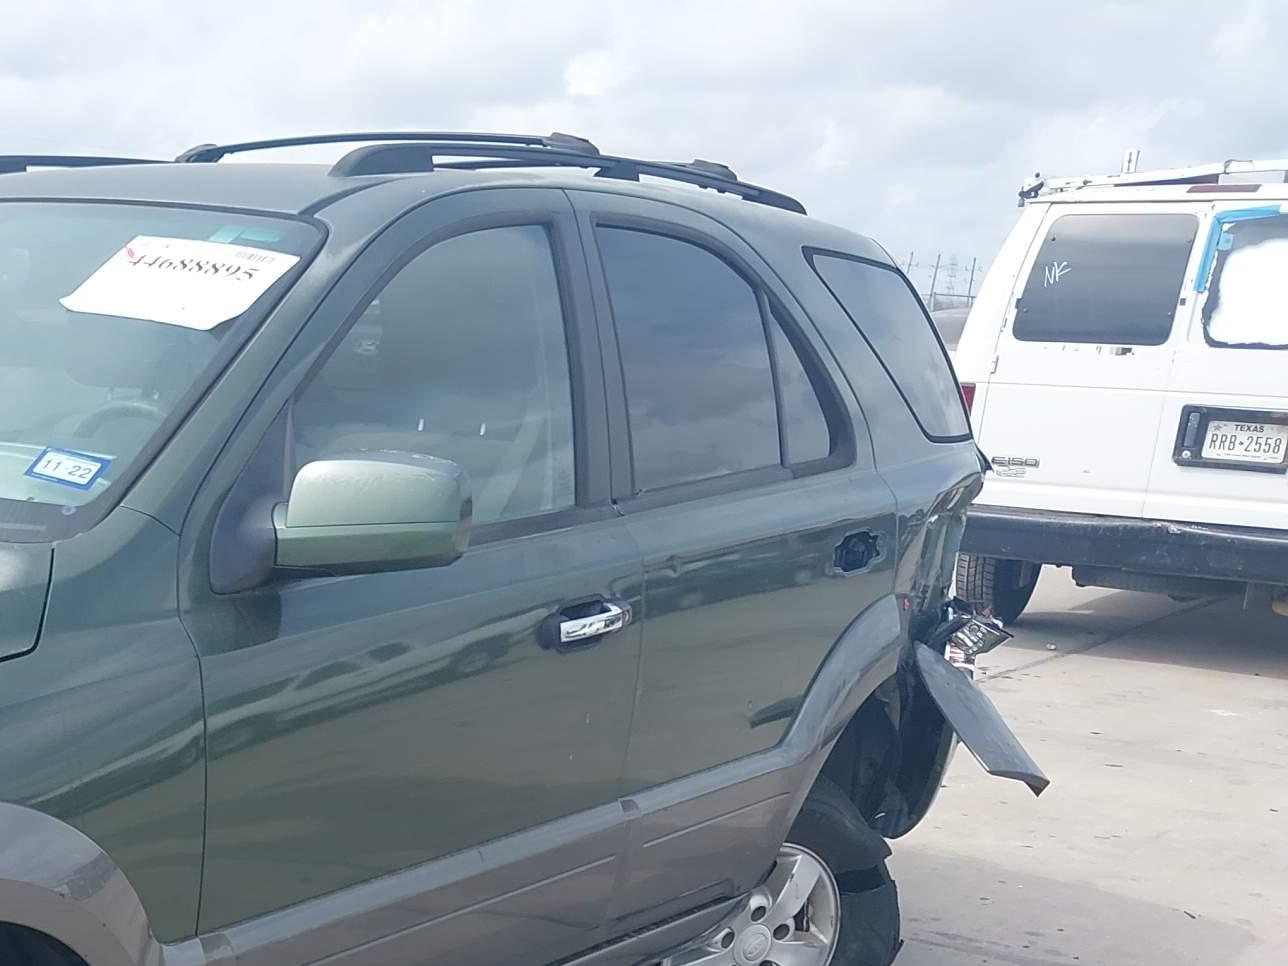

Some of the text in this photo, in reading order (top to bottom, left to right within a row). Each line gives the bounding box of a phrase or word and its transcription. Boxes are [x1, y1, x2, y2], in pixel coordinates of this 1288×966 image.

[1234, 423, 1265, 433] TEXAS
[42, 459, 92, 479] 11 22
